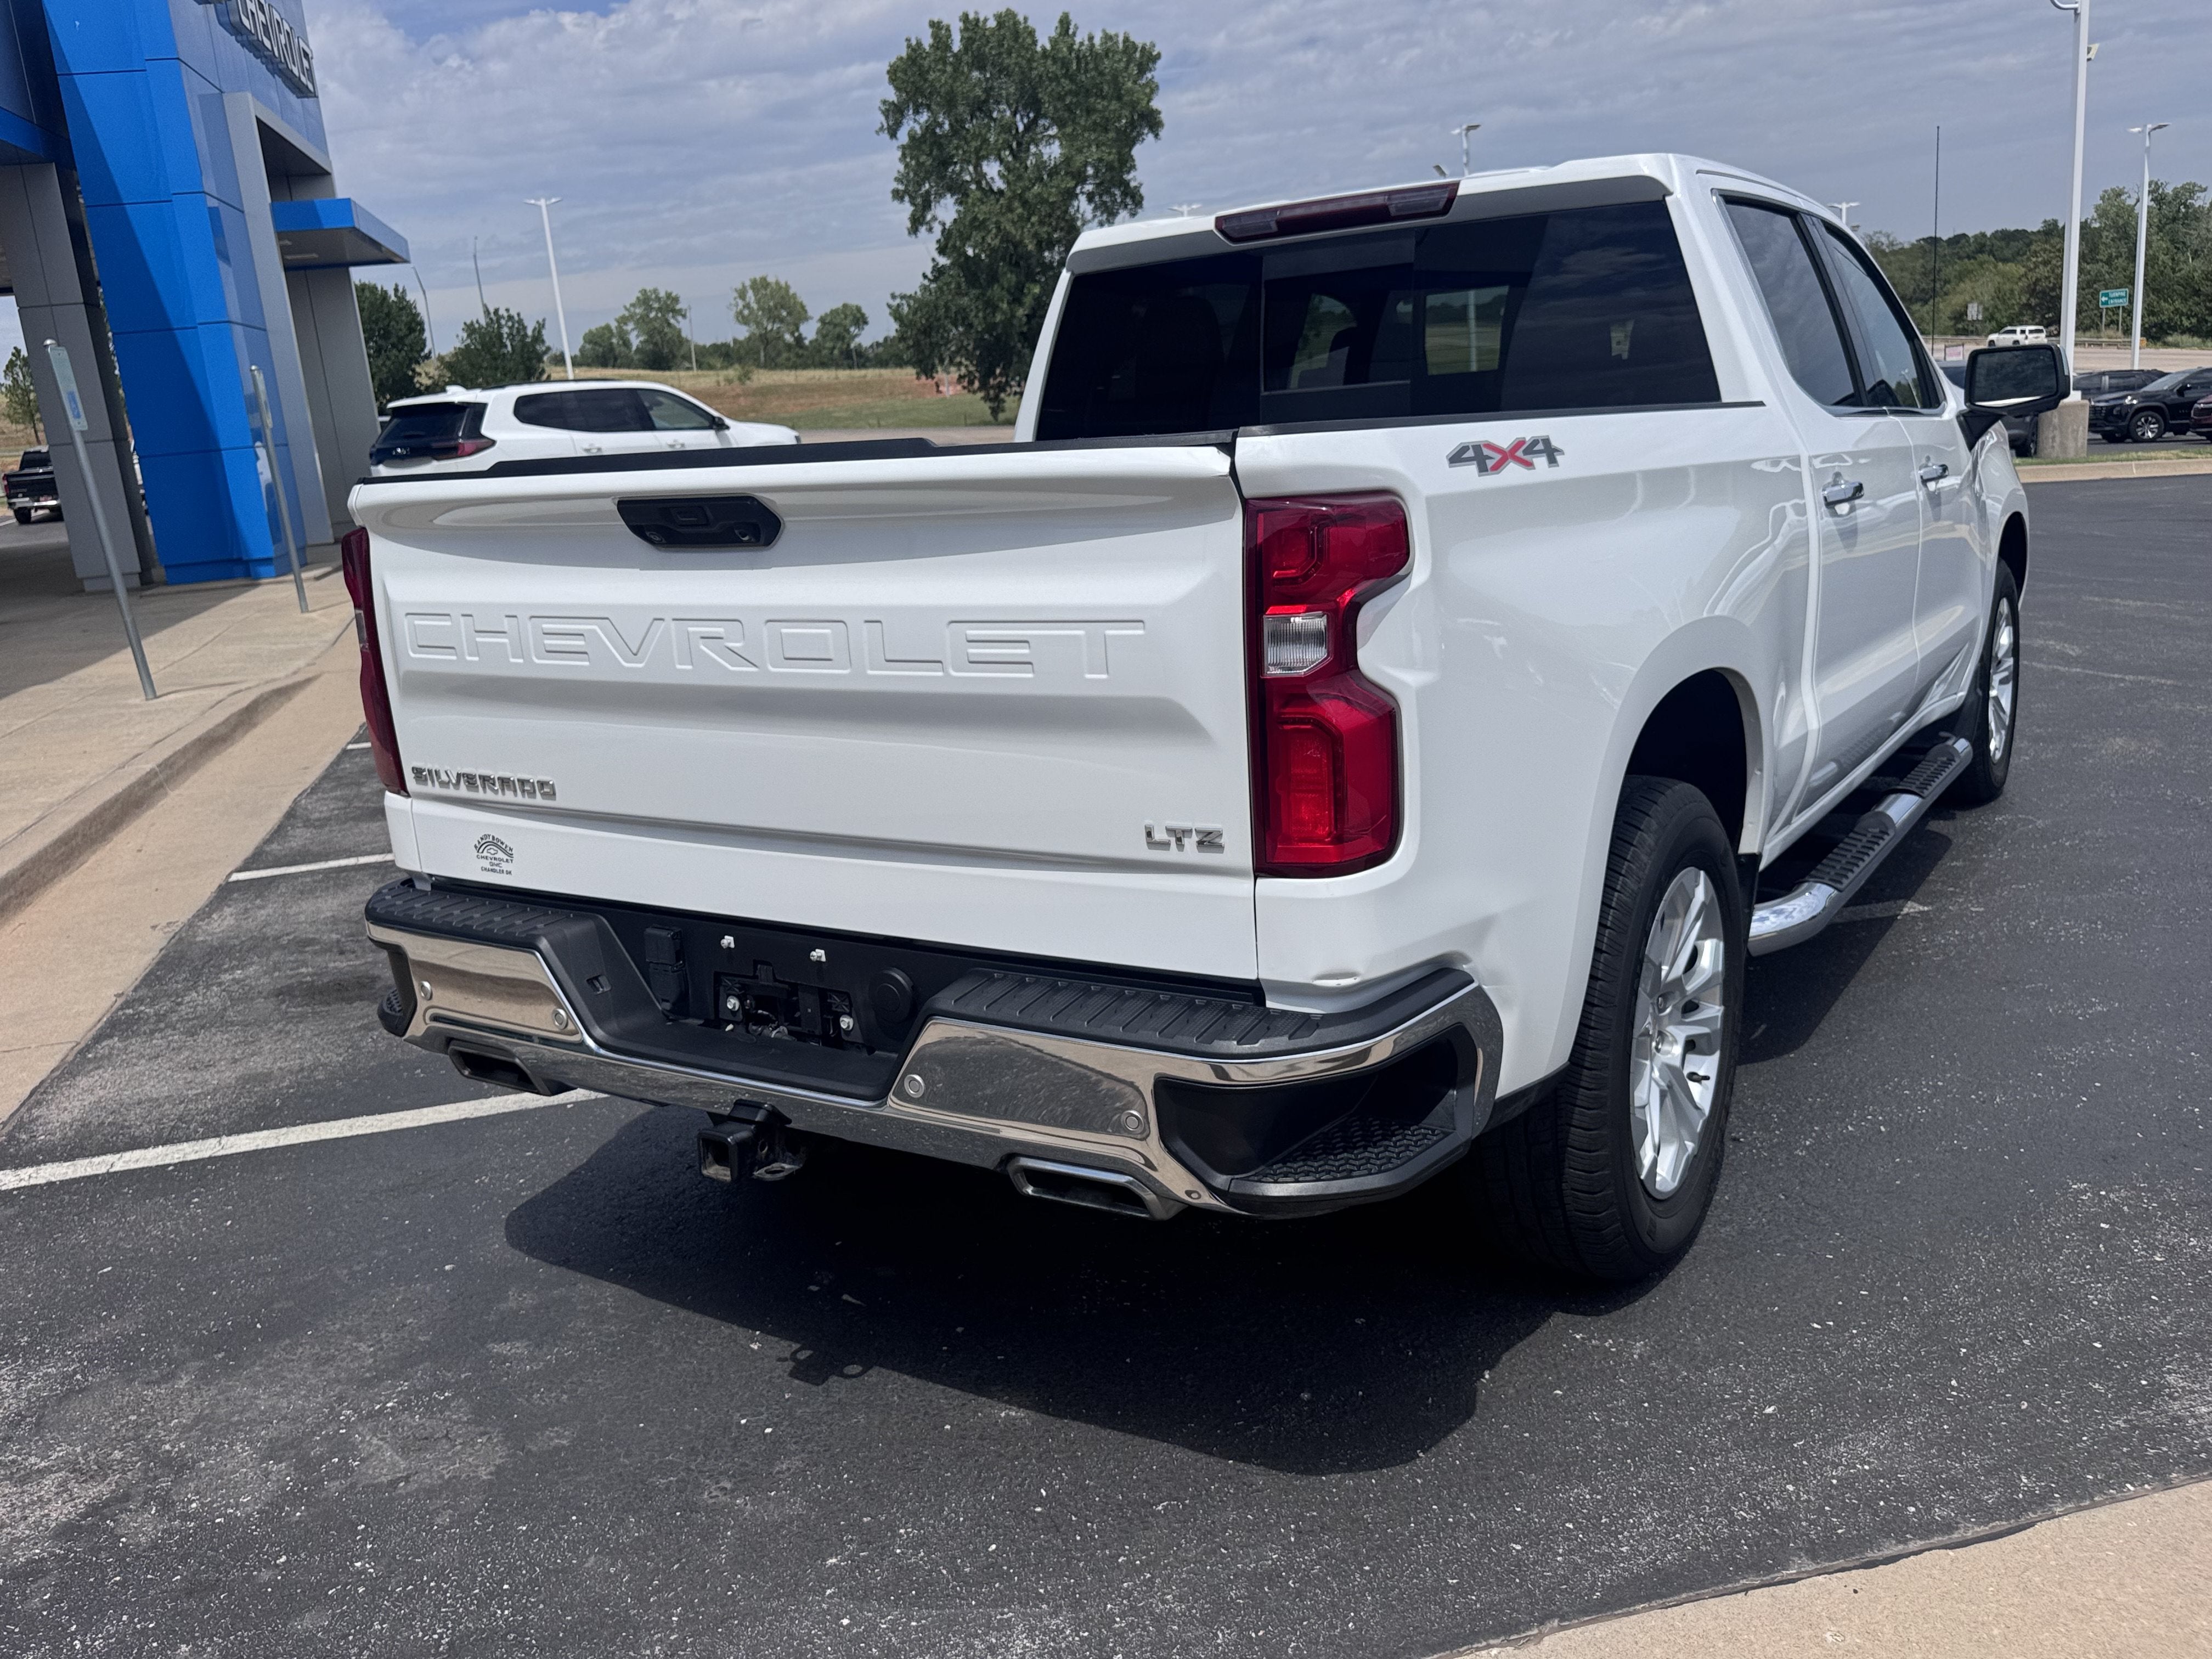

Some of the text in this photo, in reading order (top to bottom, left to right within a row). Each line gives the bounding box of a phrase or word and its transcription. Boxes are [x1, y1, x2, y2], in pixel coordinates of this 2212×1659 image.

[404, 612, 1146, 679] CHEVROLET
[411, 766, 556, 798] SILVERADO
[474, 834, 514, 853] RANDY BOWEN
[1144, 824, 1224, 851] LTZ
[476, 854, 514, 864] CHEVROLET
[481, 866, 504, 874] CHANDLER
